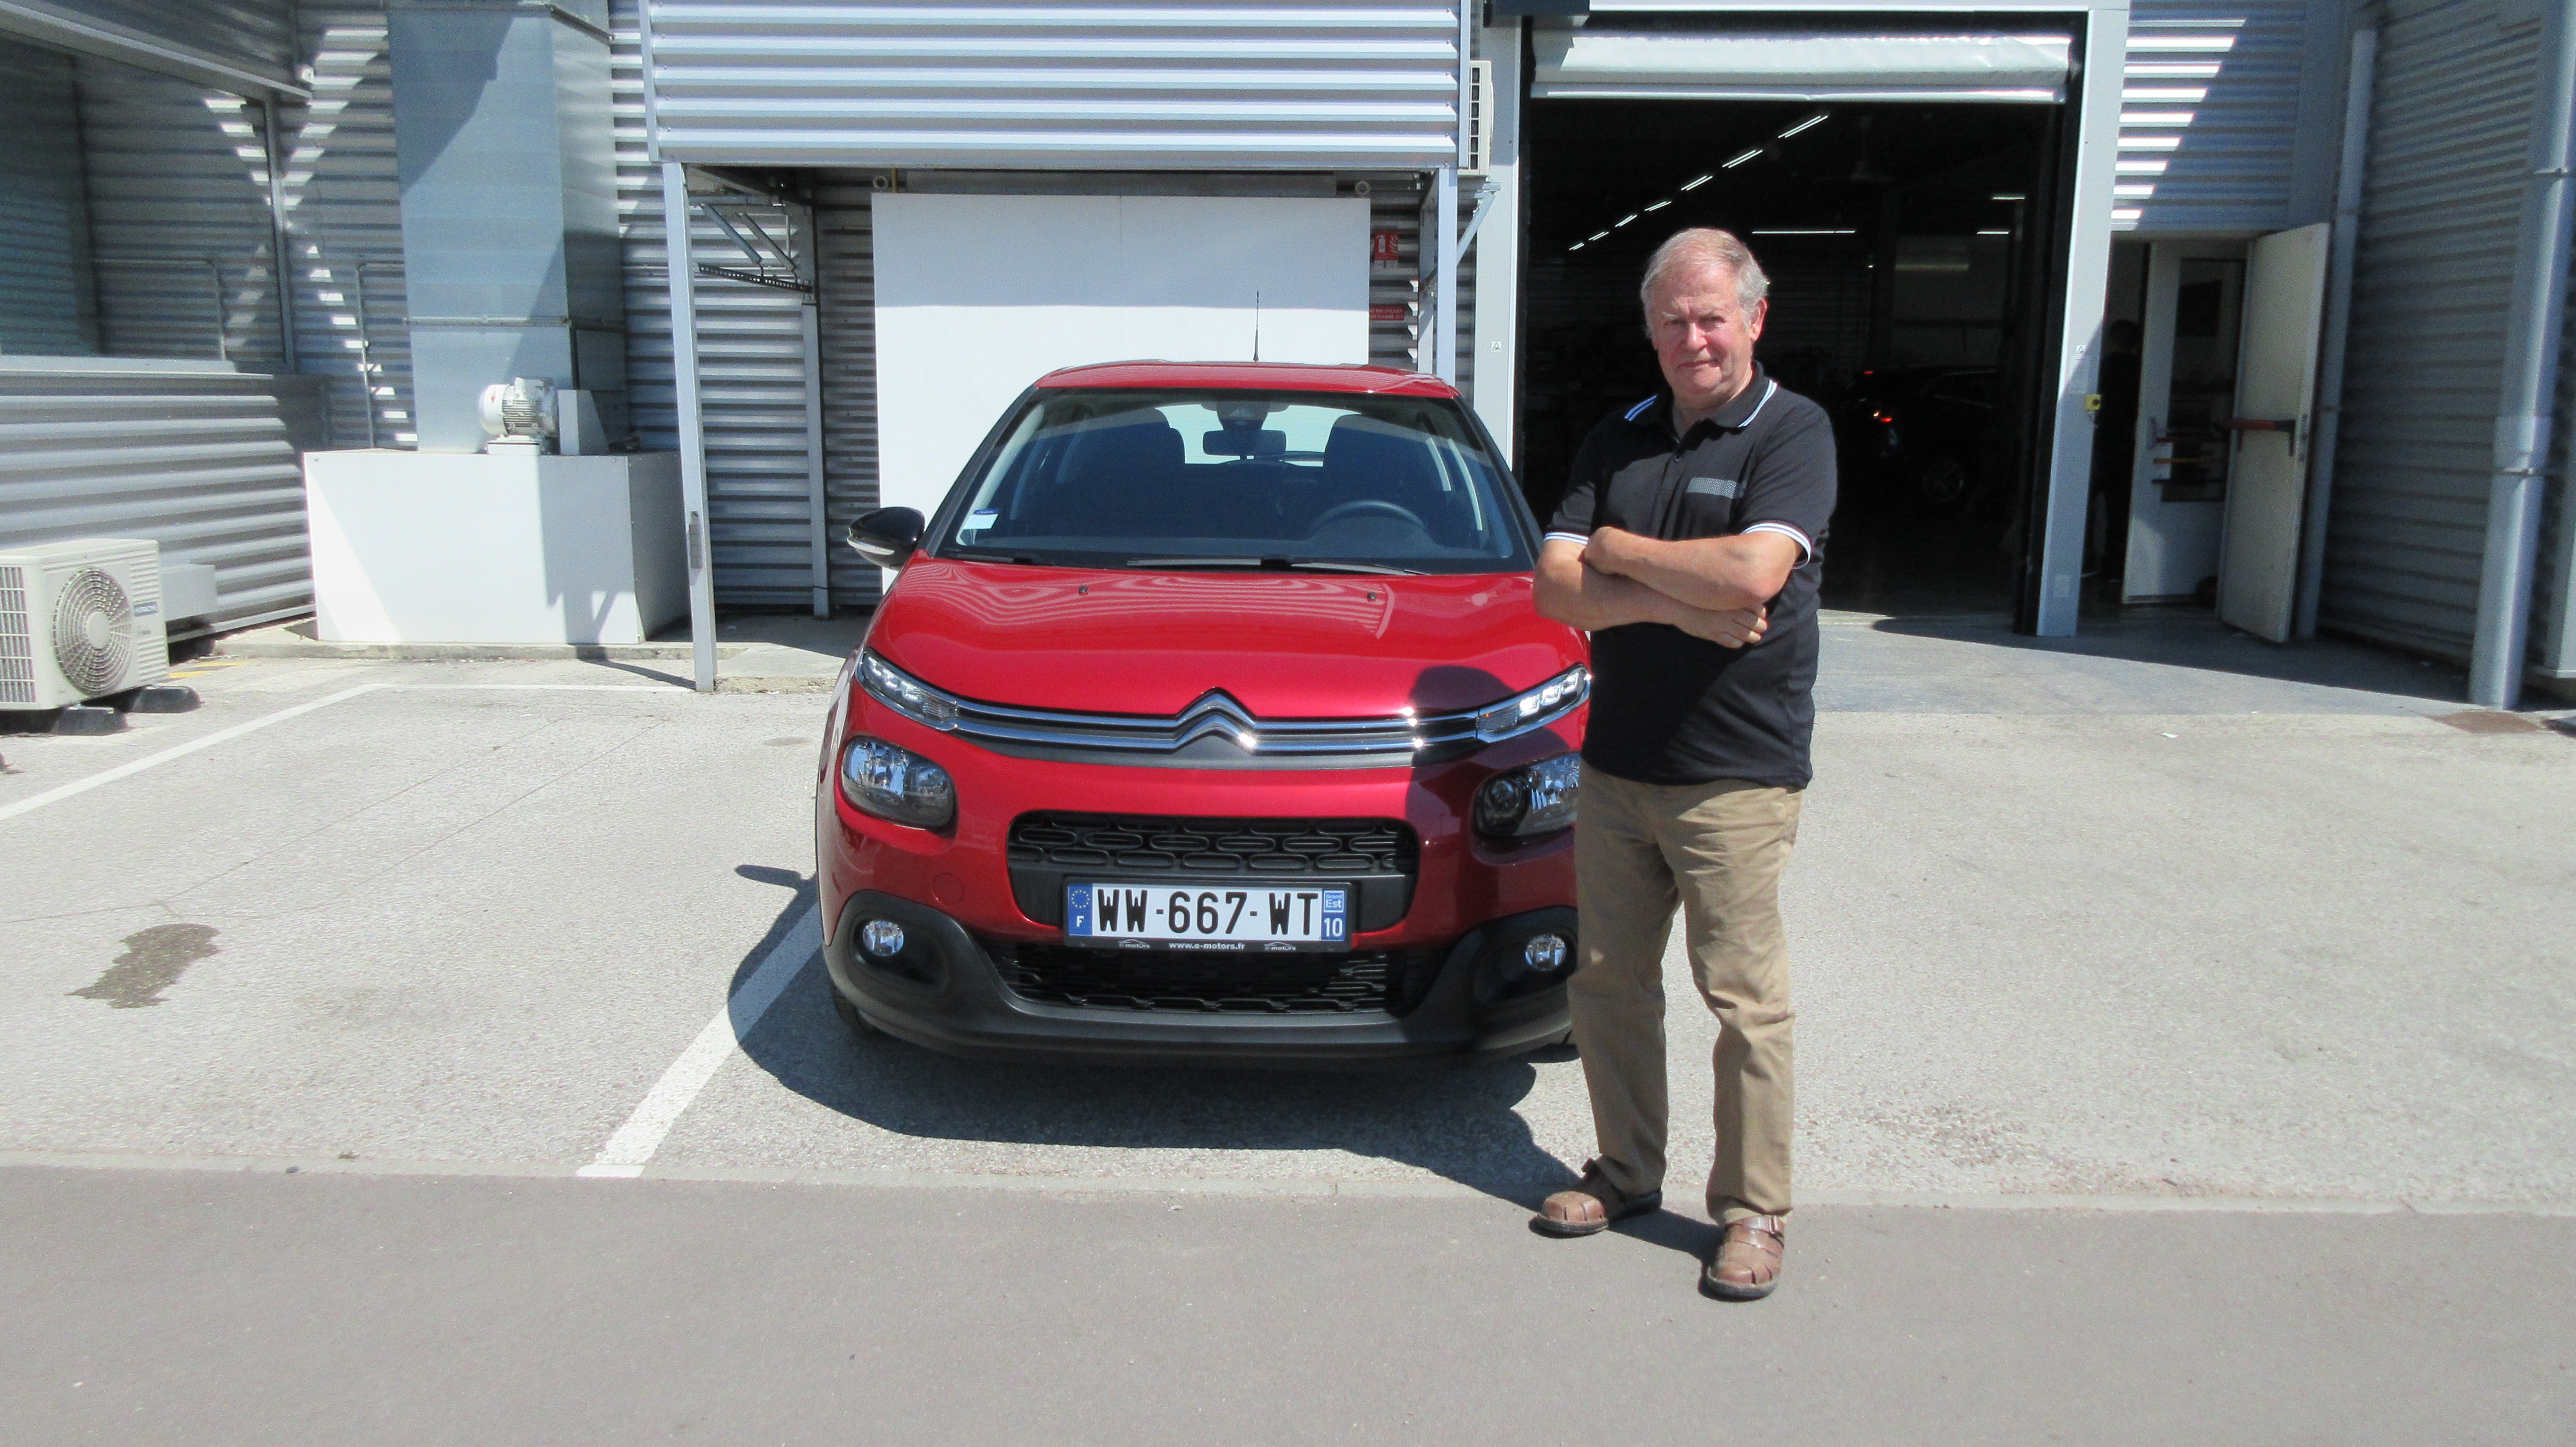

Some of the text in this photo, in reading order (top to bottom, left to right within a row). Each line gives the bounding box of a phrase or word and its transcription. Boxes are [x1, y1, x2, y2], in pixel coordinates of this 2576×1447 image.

[1326, 899, 1342, 908] Est
[1076, 915, 1084, 928] F
[1323, 917, 1343, 937] 10
